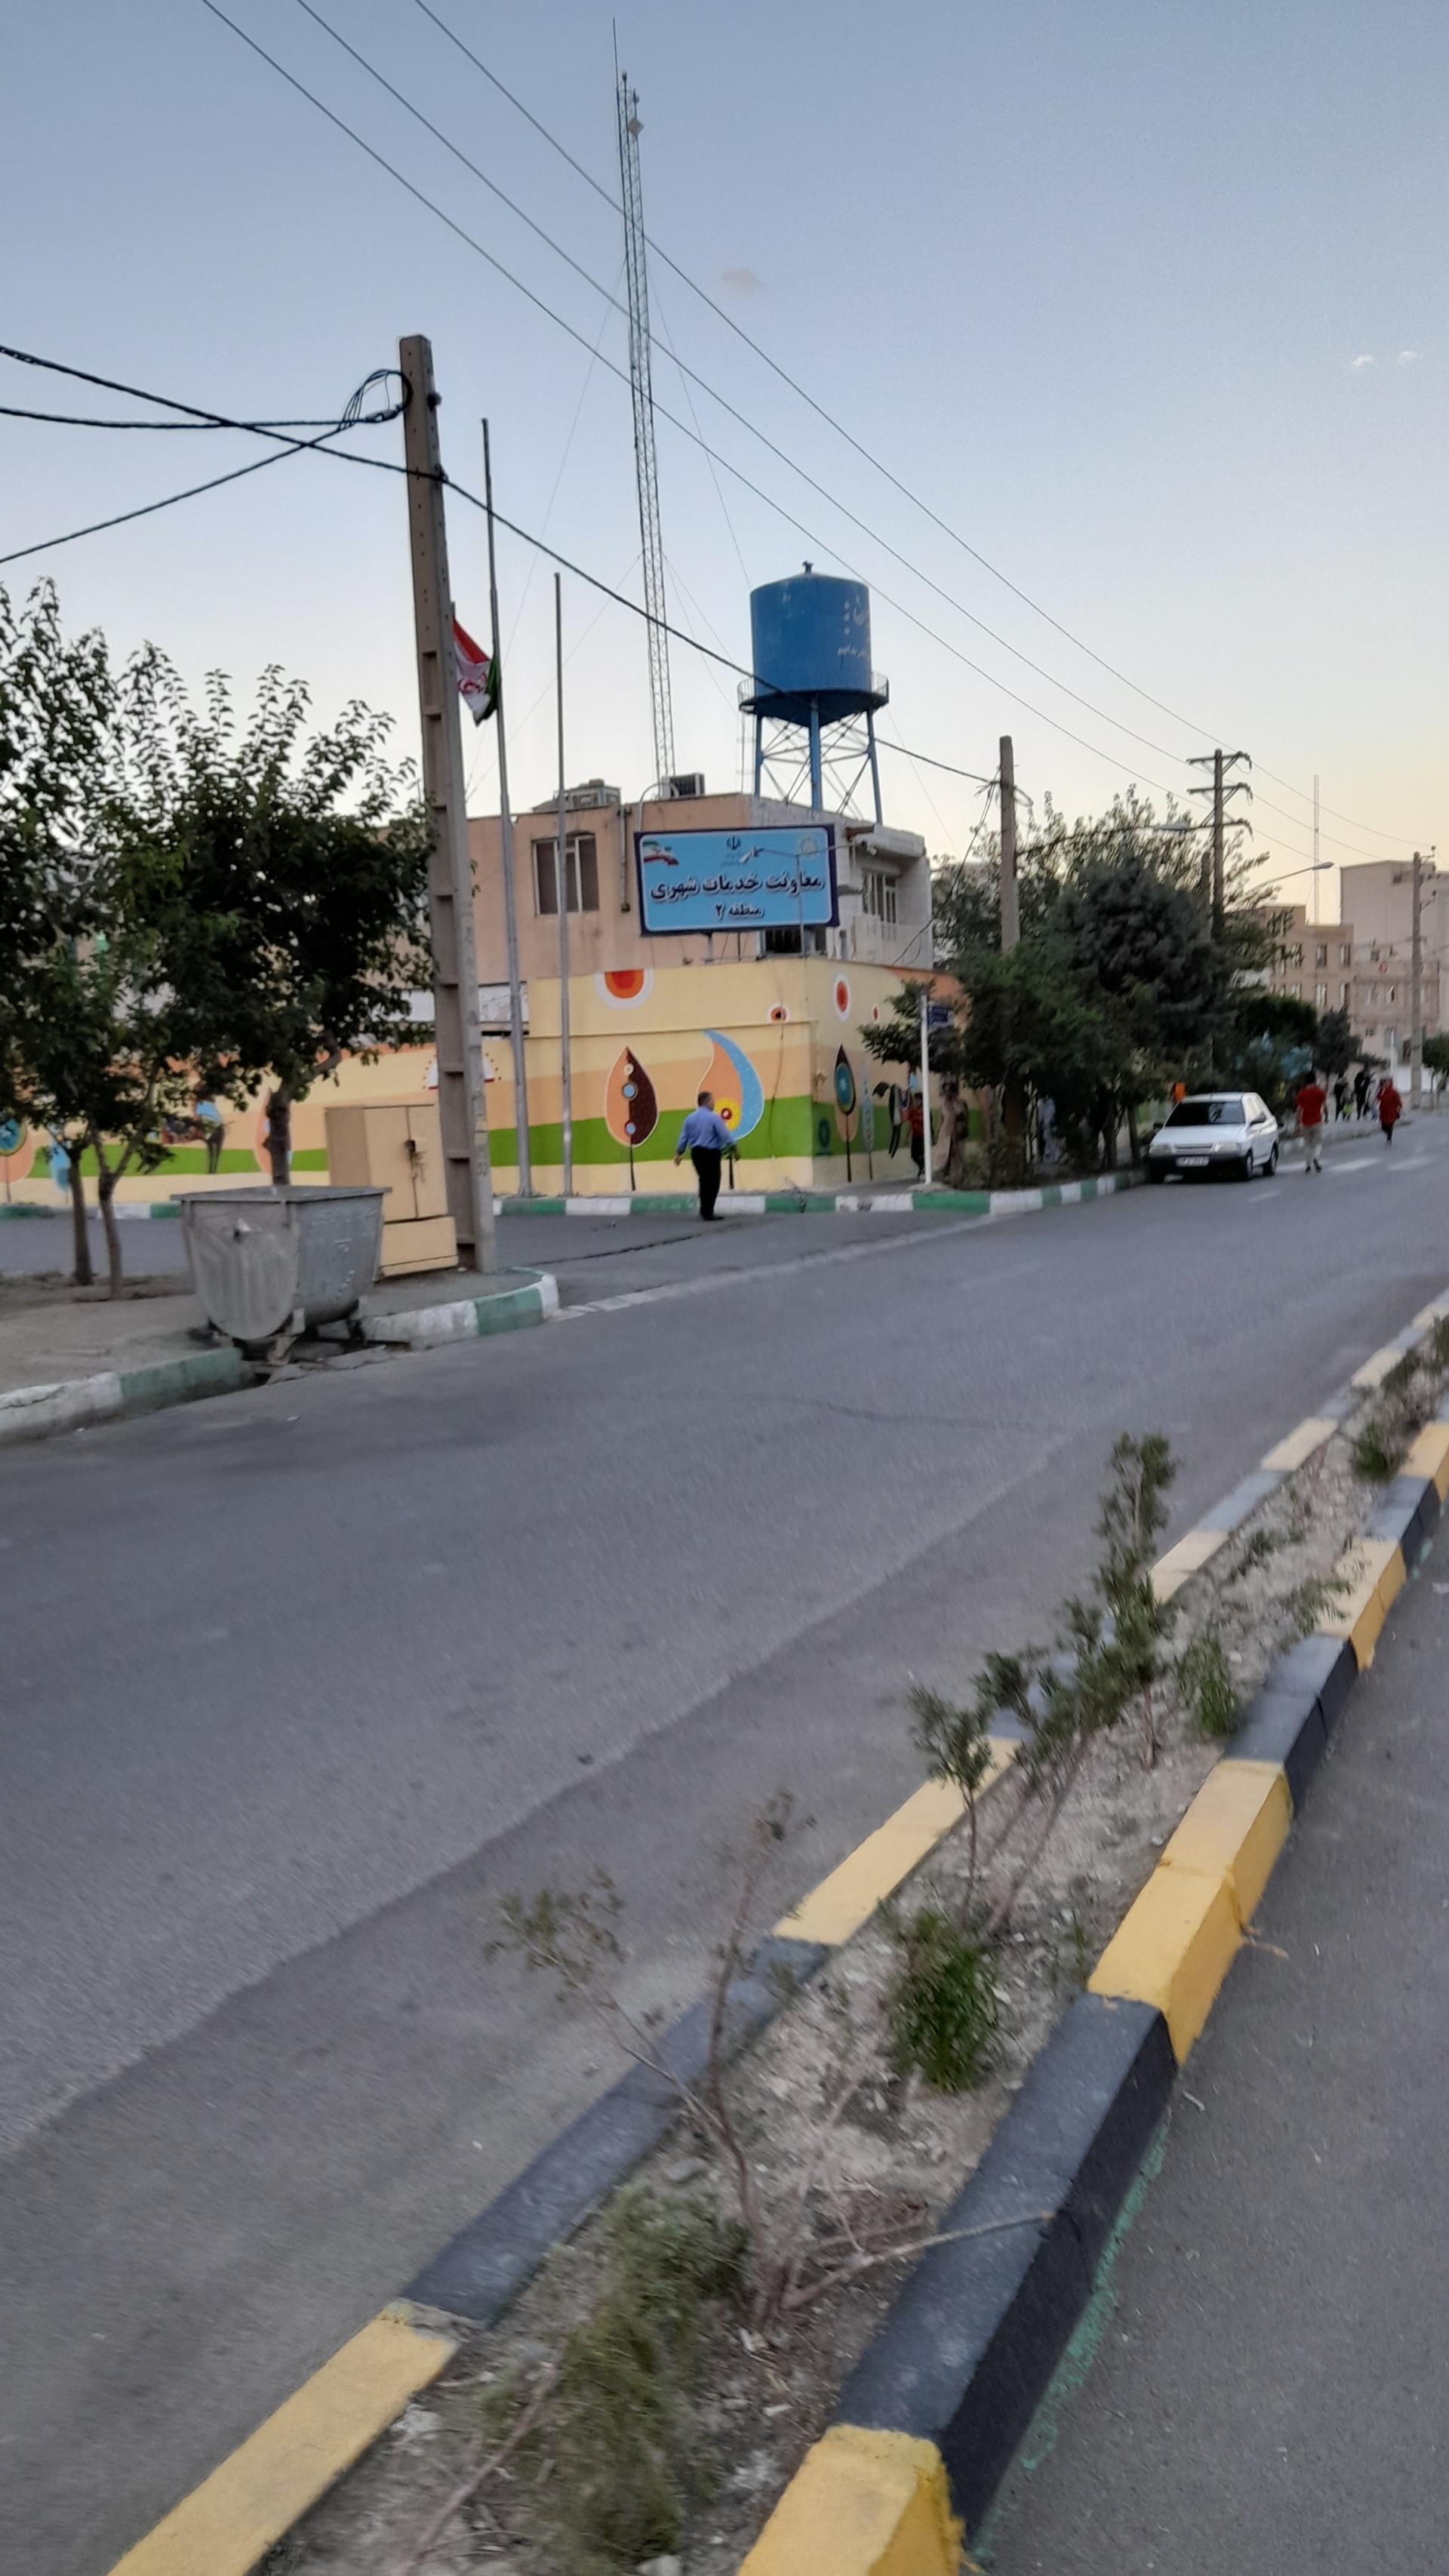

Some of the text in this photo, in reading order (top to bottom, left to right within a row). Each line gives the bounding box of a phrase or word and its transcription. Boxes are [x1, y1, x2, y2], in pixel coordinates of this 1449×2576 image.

[651, 870, 825, 902] معاونت خدمات شهری
[728, 903, 765, 919] منطقه
